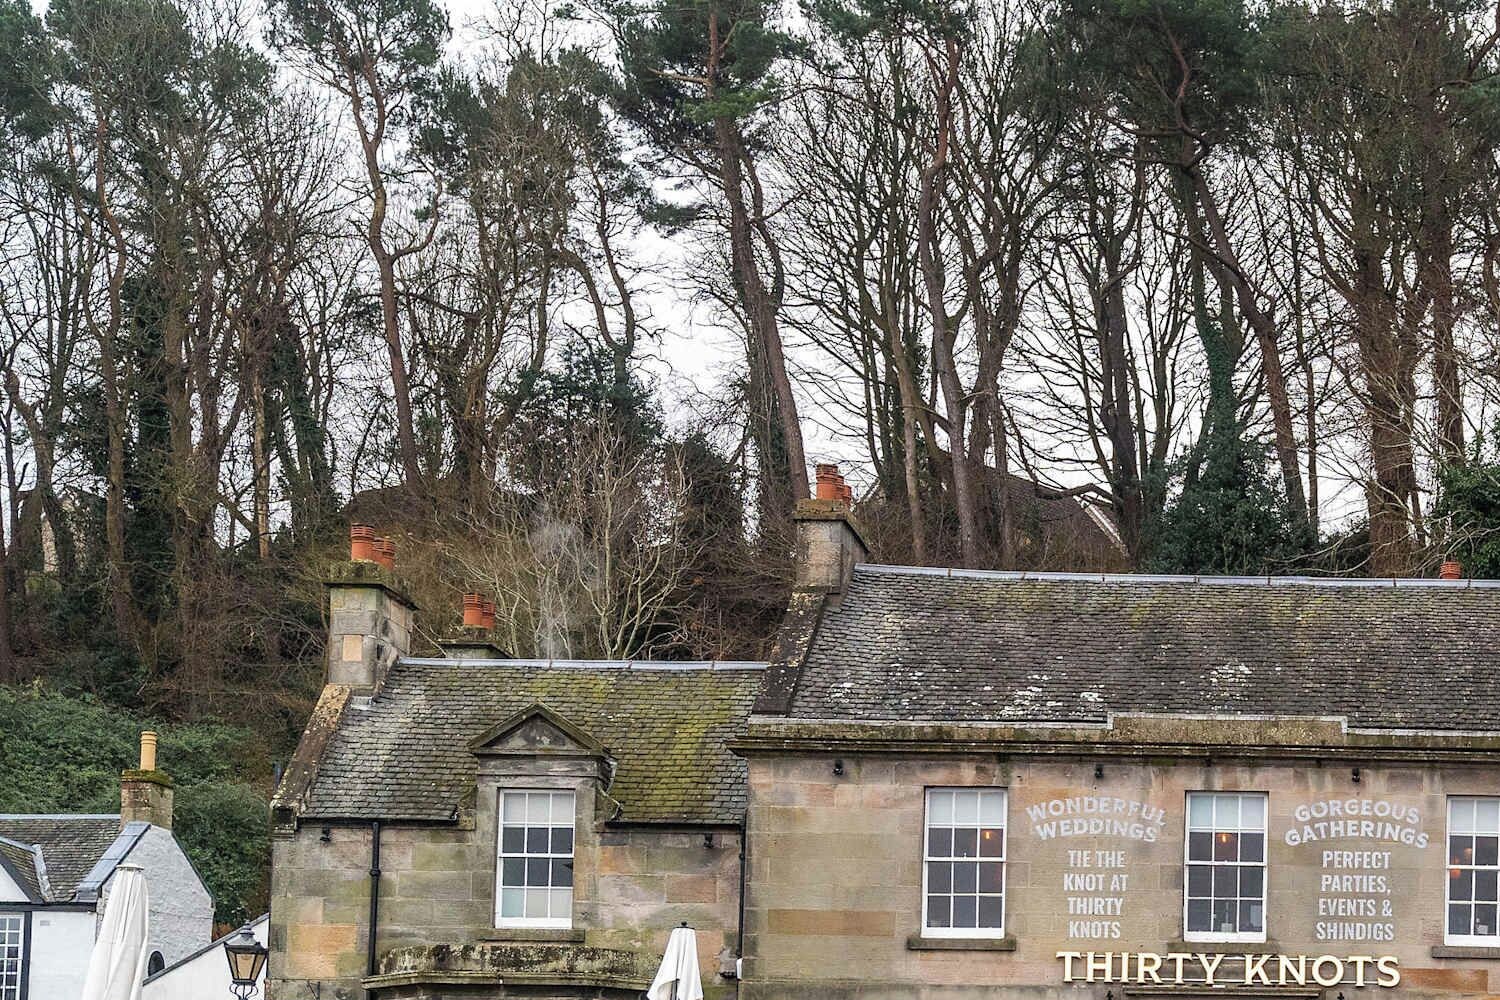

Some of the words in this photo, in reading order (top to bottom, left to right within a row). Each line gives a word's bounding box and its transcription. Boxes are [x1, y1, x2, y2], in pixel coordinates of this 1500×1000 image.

[1026, 797, 1166, 826] WONDERFUL
[1295, 799, 1420, 824] GORGEOUS
[1036, 818, 1156, 842] WEDDINGS
[1285, 820, 1429, 848] GATHERINGS
[1068, 850, 1091, 867] TIE
[1095, 850, 1126, 867] THE
[1322, 851, 1391, 869] PERFECT
[1063, 873, 1104, 891] KNOT
[1110, 874, 1128, 891] AT
[1321, 875, 1391, 895] PARTIES,
[1067, 897, 1123, 915] THIRTY
[1318, 899, 1376, 916] EVENTS
[1382, 899, 1392, 916] &
[1069, 921, 1121, 938] KNOTS
[1316, 922, 1394, 940] SHINDIGS
[1056, 951, 1225, 985] THIRTY
[1244, 953, 1401, 988] KNOTS
